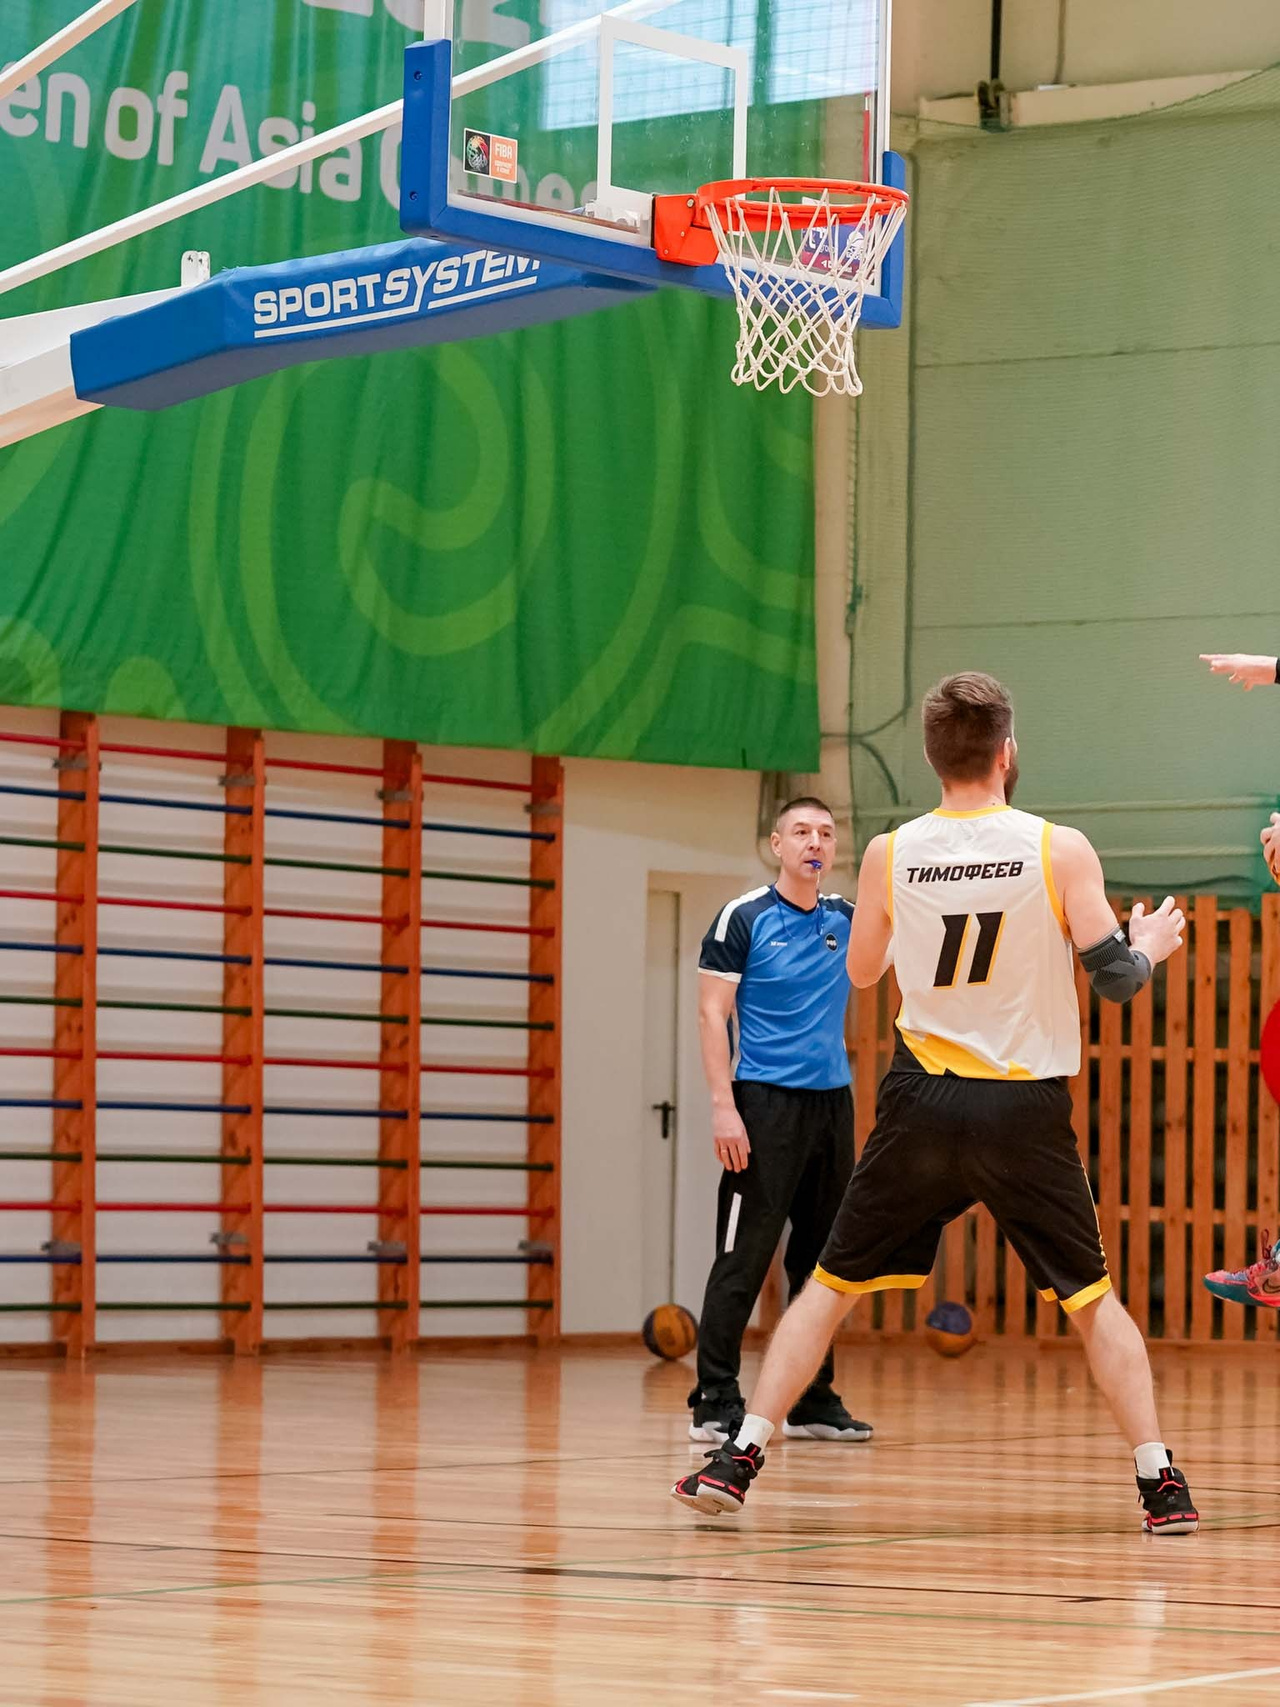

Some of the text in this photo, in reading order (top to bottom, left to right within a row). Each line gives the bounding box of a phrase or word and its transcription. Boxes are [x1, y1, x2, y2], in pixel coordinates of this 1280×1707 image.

[104, 70, 189, 166] of
[199, 84, 363, 202] Asia
[494, 142, 513, 159] FIBA
[907, 861, 1023, 883] ТИМОФЕЕВ
[932, 911, 1005, 988] 11
